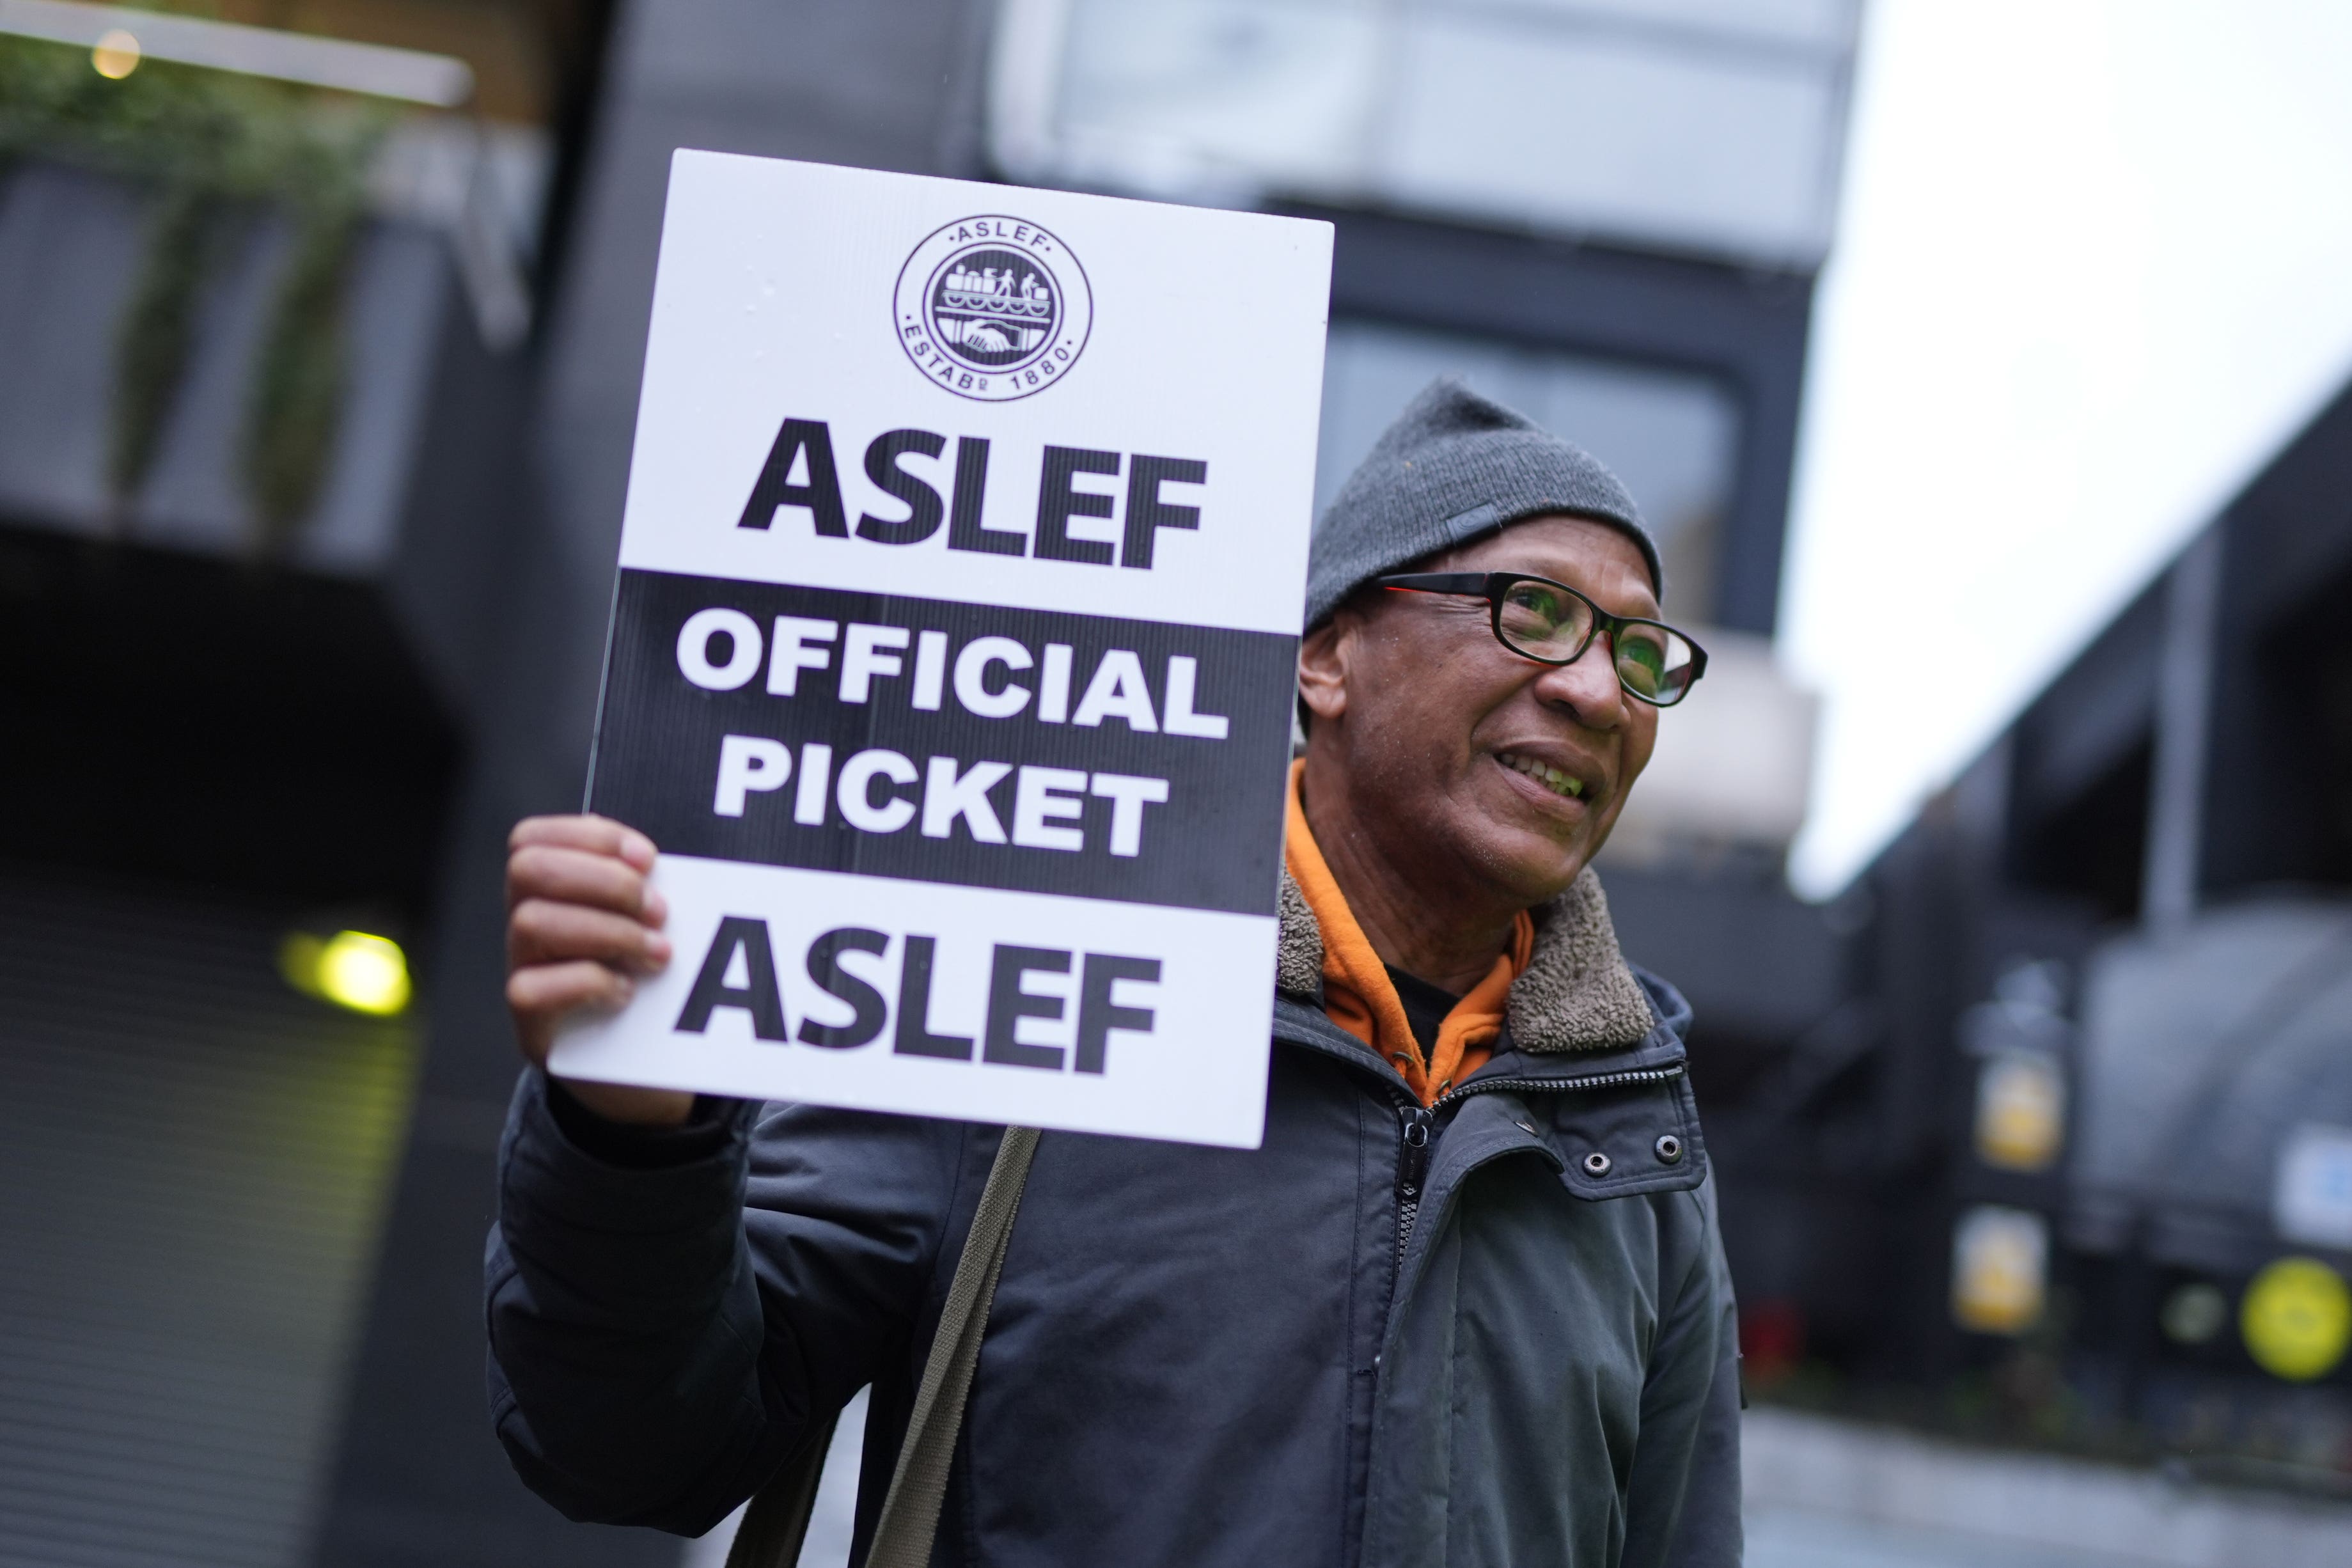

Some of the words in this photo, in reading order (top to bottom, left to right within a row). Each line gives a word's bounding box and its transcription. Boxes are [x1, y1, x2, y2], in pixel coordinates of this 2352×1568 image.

[958, 221, 1048, 246] ASLEF
[1010, 346, 1069, 391] 1880
[737, 418, 1207, 570] ASLEF
[676, 608, 1230, 741] OFFICIAL
[713, 733, 1170, 858] PICKET
[673, 914, 1163, 1076] ASLEF
